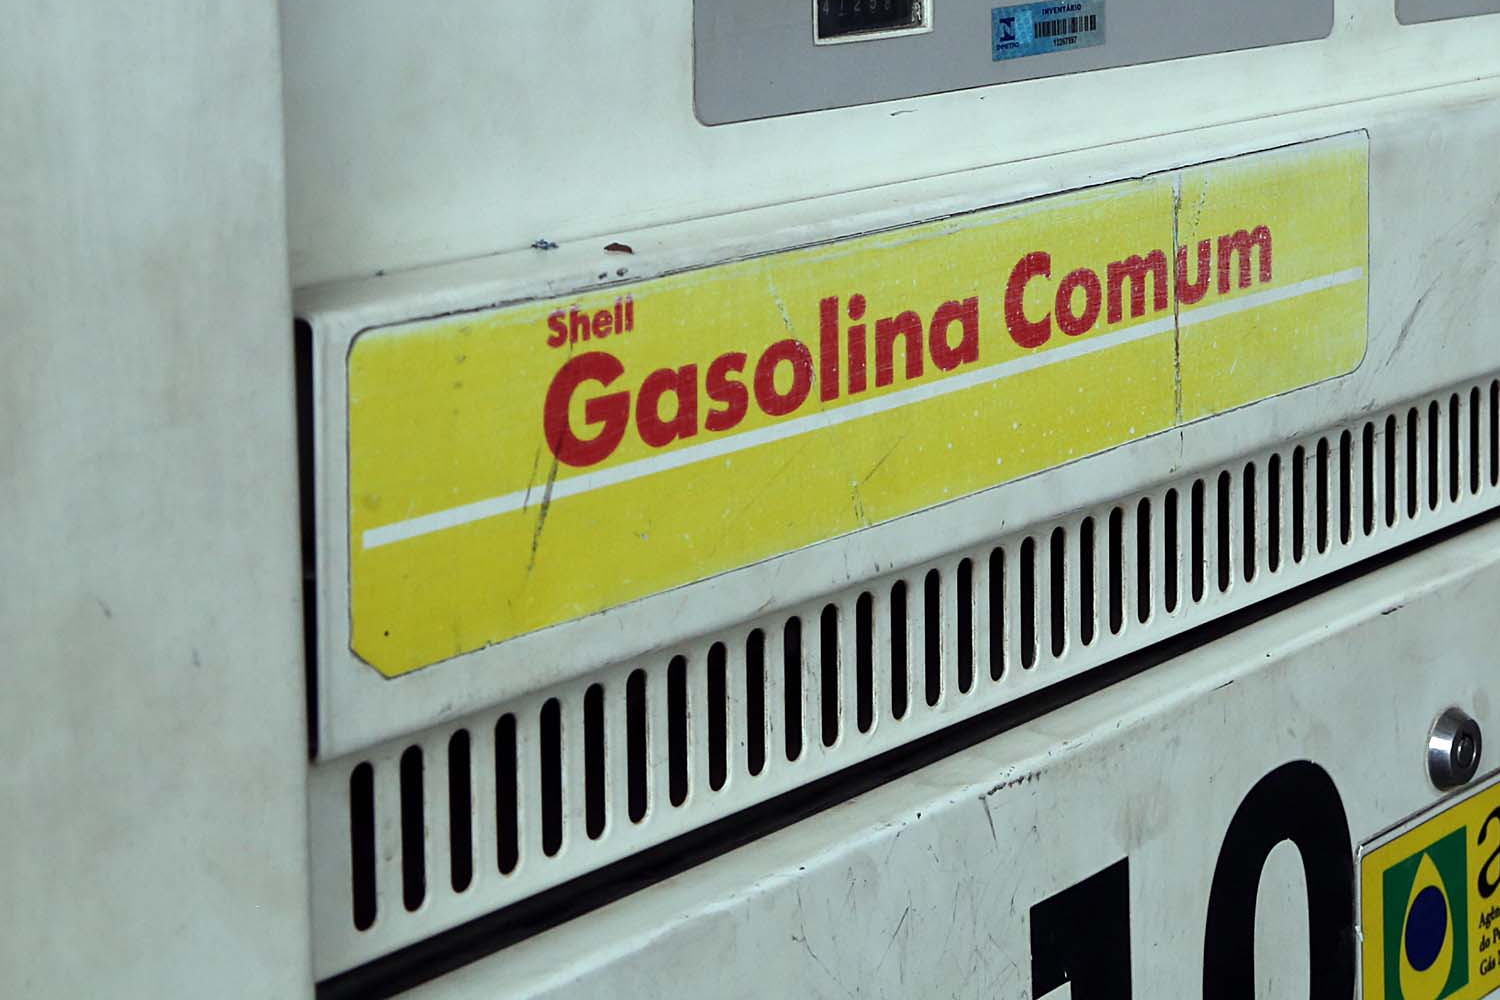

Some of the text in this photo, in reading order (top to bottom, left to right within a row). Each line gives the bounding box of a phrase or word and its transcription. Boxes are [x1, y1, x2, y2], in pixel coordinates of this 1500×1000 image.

[543, 223, 1273, 468] Gasolina Comum
[546, 294, 633, 349] Shell
[1479, 933, 1491, 953] do
